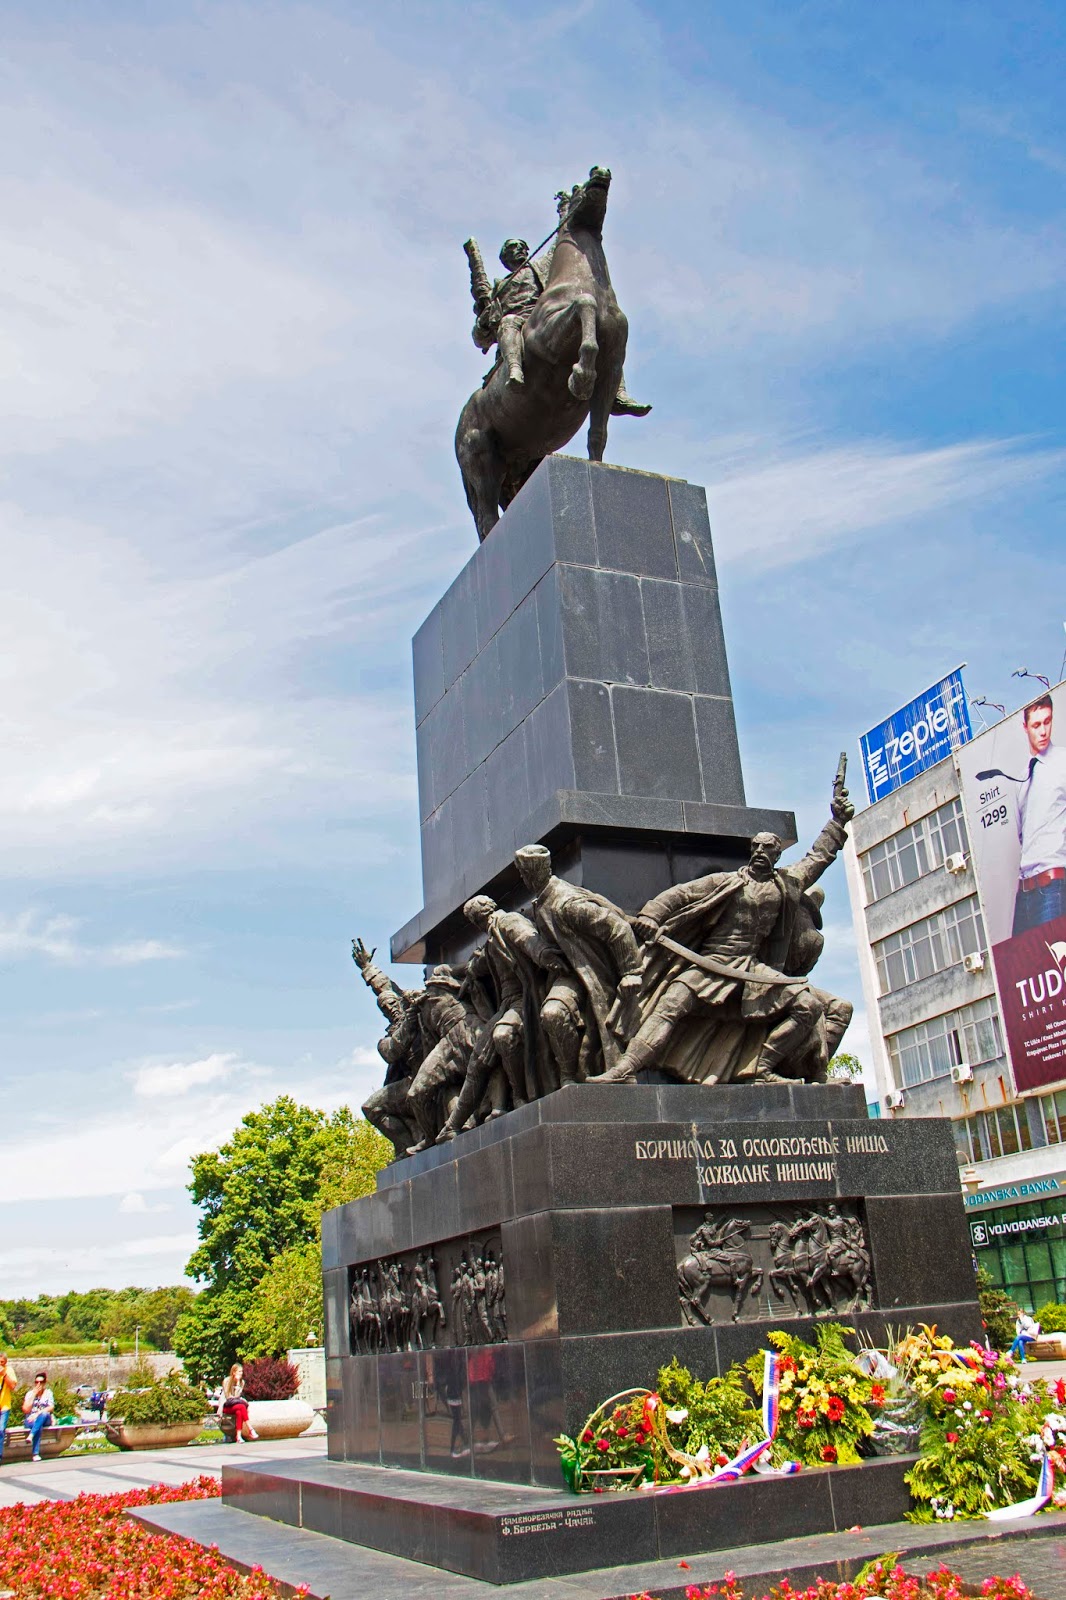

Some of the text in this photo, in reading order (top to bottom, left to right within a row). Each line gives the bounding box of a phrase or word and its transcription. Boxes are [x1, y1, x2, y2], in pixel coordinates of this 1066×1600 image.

[885, 693, 963, 764] zepter
[980, 786, 1000, 805] Shirt
[981, 805, 1007, 829] 1299
[1022, 1003, 1053, 1021] SHIRT
[635, 1135, 890, 1161] БОРЦИМА ЗА ОСЛОБОЂЕЊЕ НИША
[697, 1161, 839, 1187] ЗАХВАЛНЕ НИШЛИЈЕ
[1020, 1178, 1060, 1196] BANKA
[989, 1215, 1060, 1236] VOJVOĐANSKA
